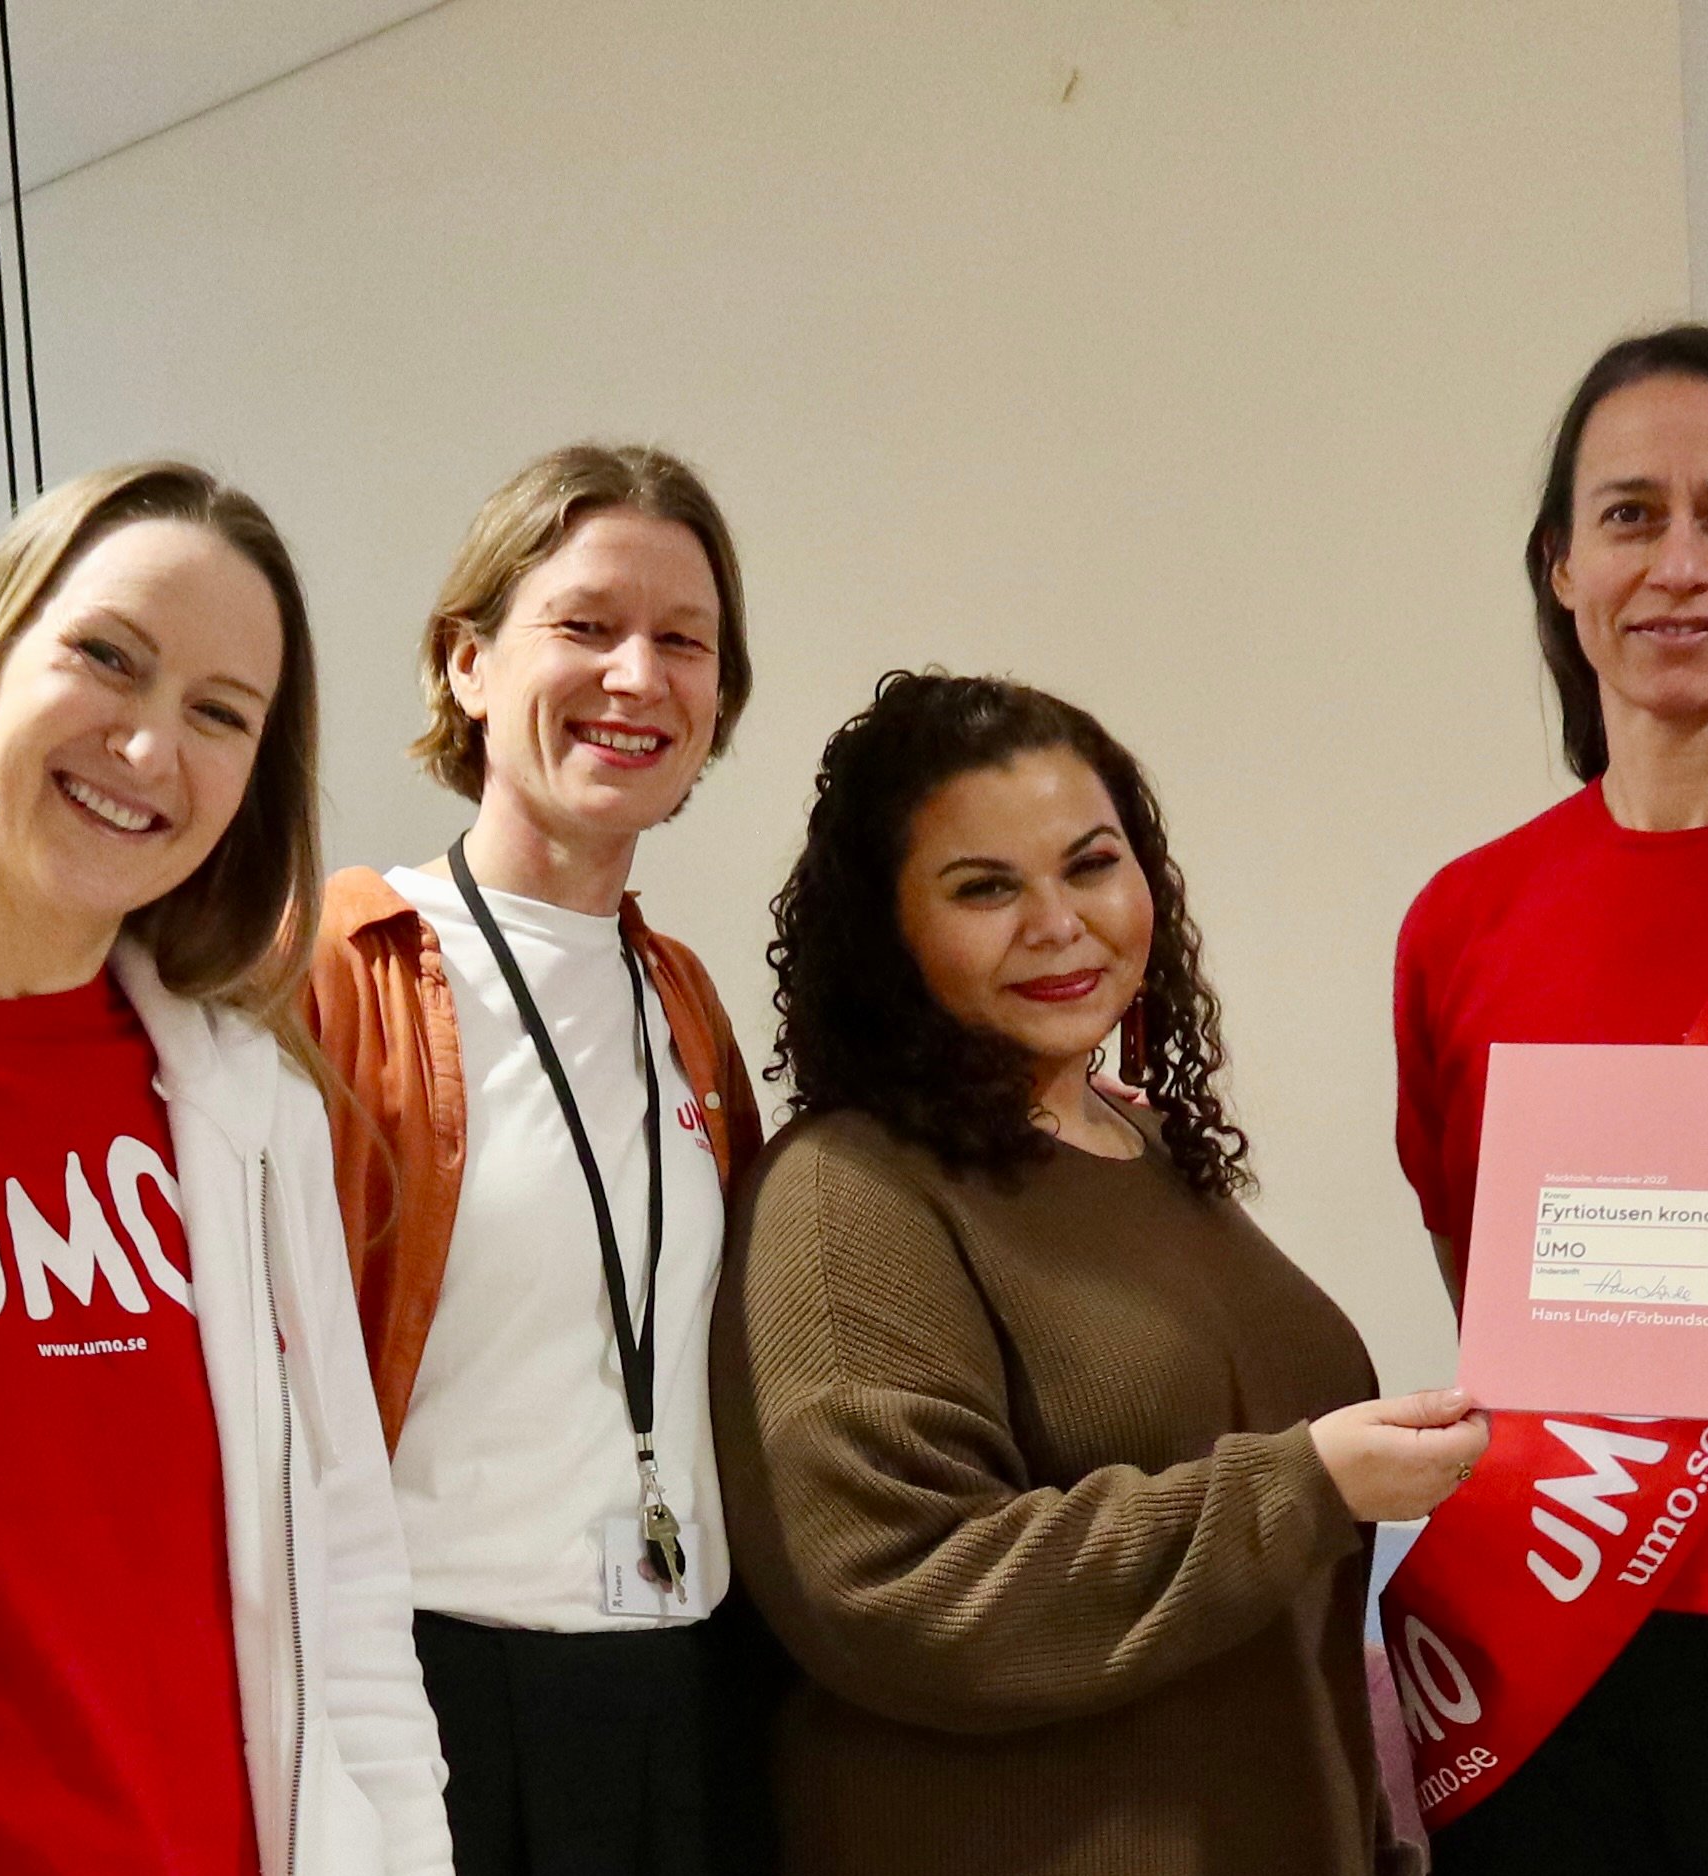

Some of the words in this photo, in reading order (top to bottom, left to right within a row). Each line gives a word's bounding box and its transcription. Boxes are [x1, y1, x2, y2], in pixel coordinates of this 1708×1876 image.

[1596, 1174, 1642, 1185] december
[1643, 1175, 1669, 1185] 2022
[1541, 1203, 1653, 1223] Fyrtiotusen
[1536, 1241, 1587, 1258] UMO
[1531, 1307, 1571, 1323] Hans
[37, 1337, 147, 1357] www.umo.se
[1526, 1415, 1669, 1603] UM
